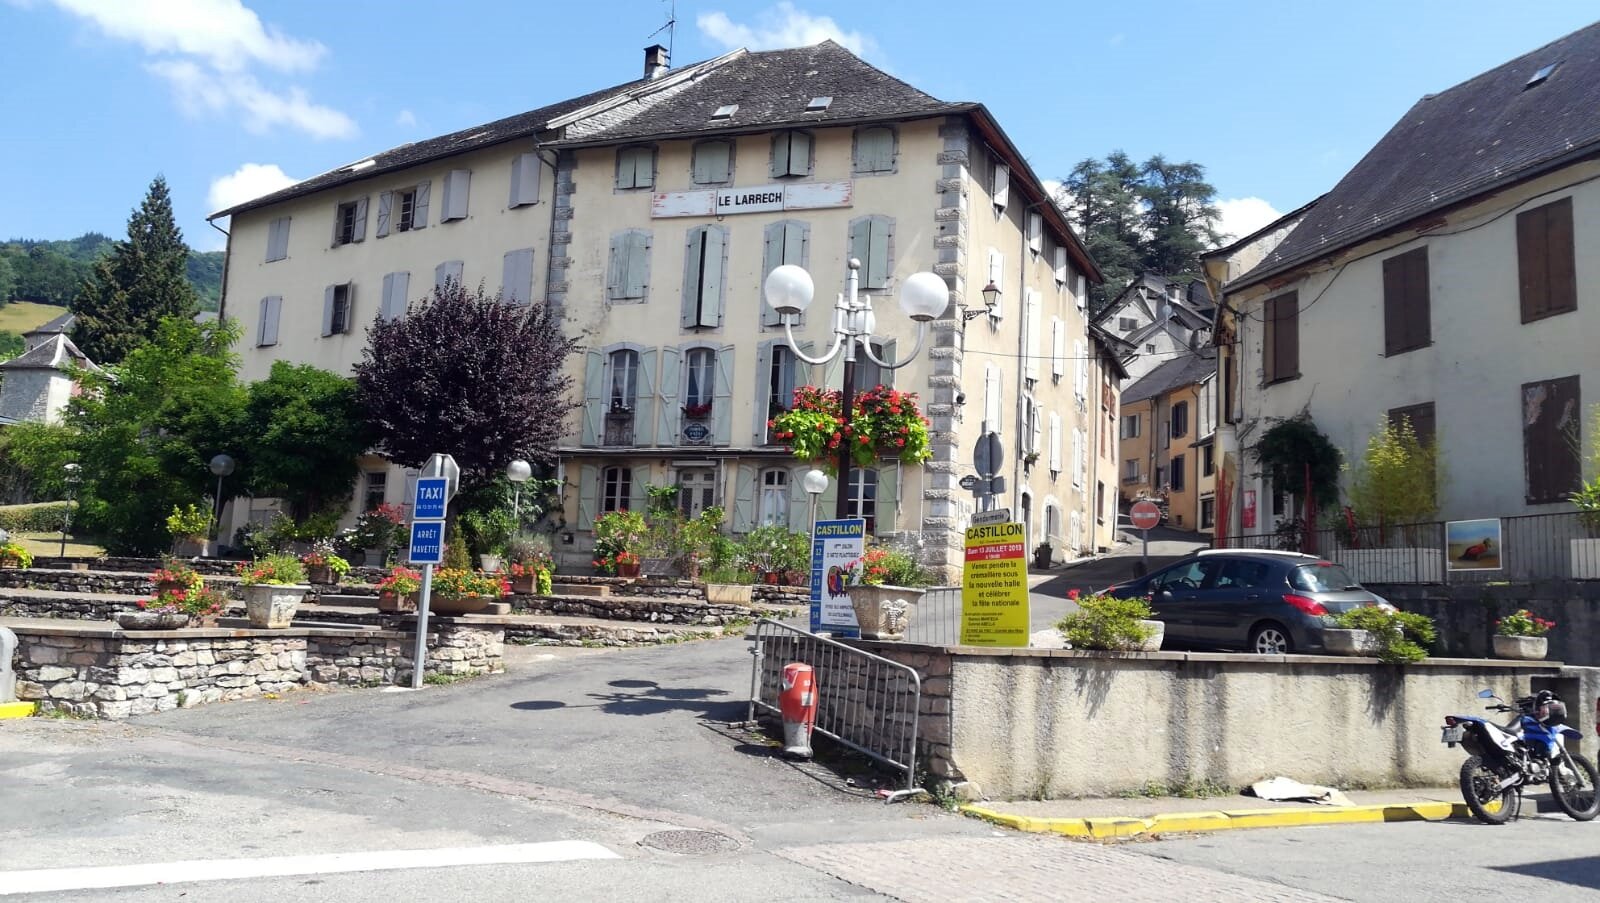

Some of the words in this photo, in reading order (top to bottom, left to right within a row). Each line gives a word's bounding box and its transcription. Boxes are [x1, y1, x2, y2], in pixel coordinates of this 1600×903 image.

[718, 196, 731, 207] LE
[735, 192, 782, 206] LARRECH
[420, 487, 443, 500] TAXI
[417, 529, 437, 539] ARRÊT
[816, 524, 862, 536] CASTILLON
[967, 524, 1022, 540] CASTILLON
[412, 545, 439, 554] NAVETTE
[985, 545, 1007, 553] JUILLET
[971, 562, 987, 570] Venez
[988, 561, 1009, 570] pendre
[969, 581, 974, 589] la
[975, 580, 1002, 588] nouvelle
[985, 590, 1010, 598] célébrer
